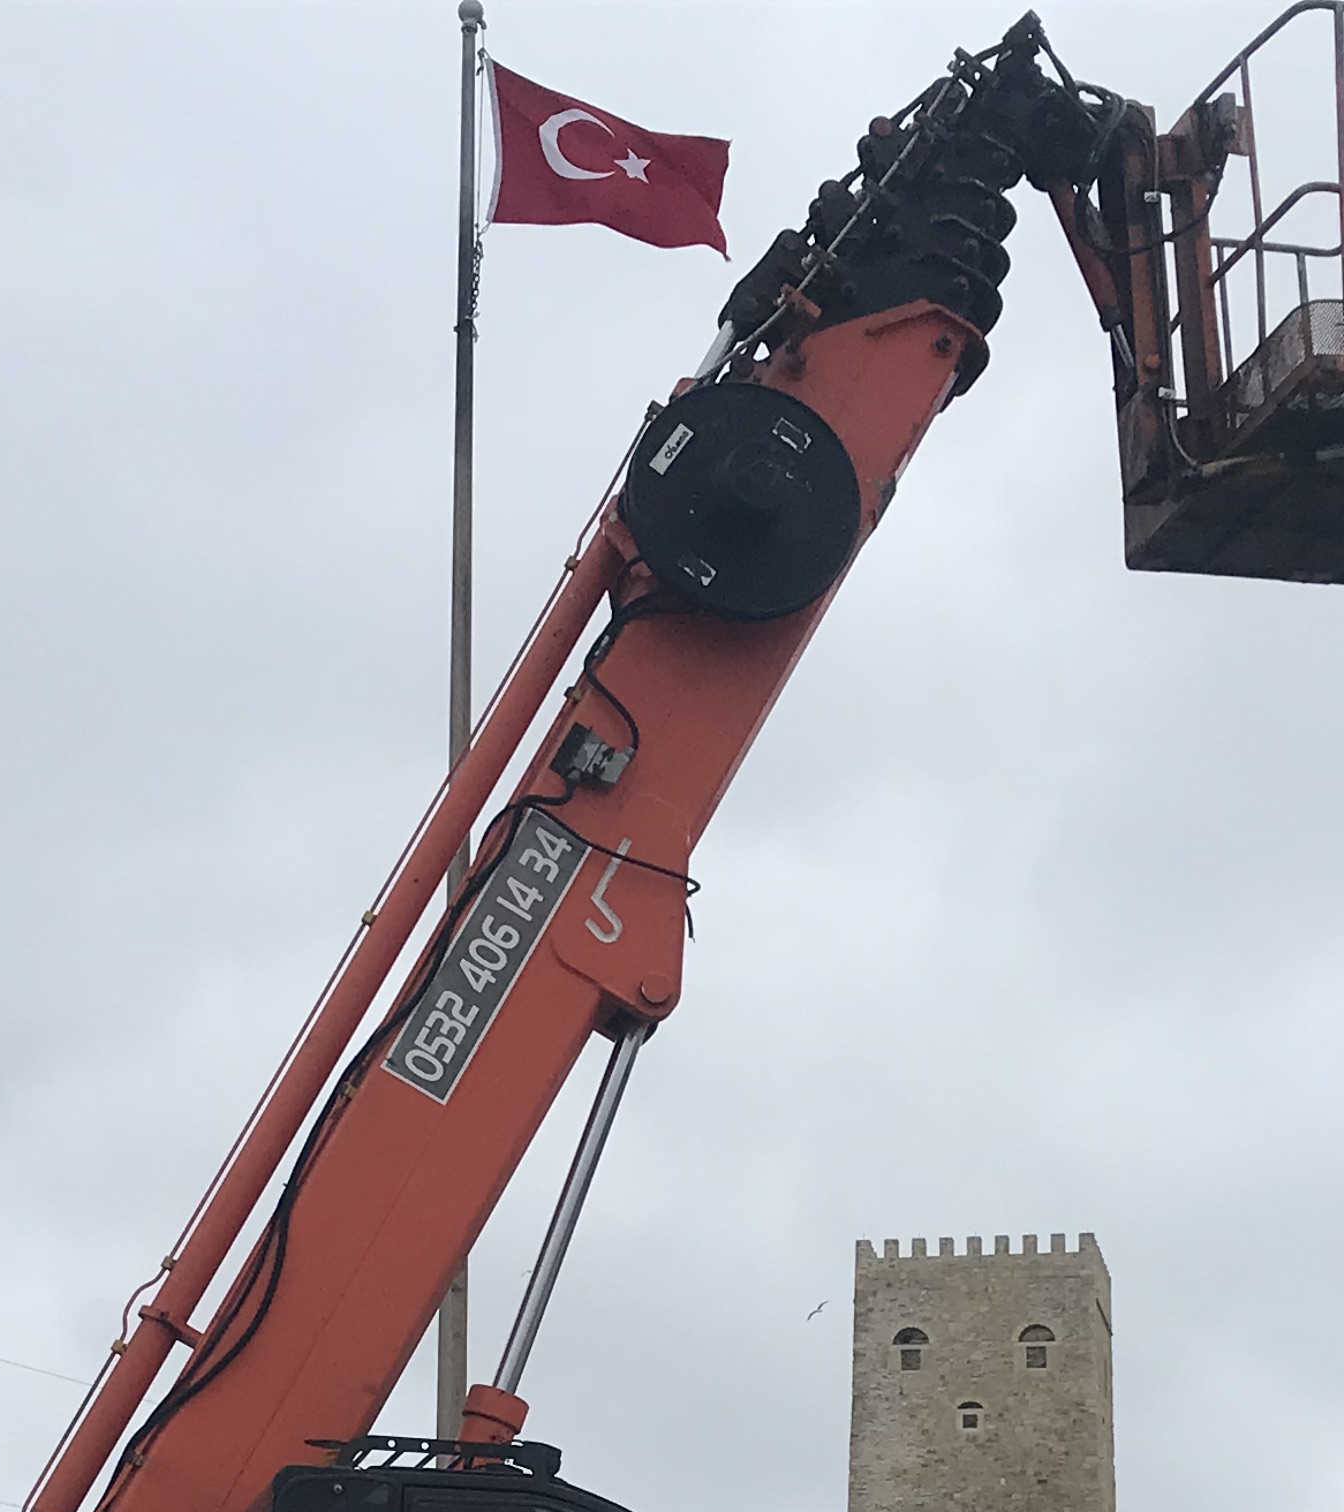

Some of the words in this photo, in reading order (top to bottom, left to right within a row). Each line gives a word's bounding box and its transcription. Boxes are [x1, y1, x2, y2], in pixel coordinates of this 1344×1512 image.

[518, 826, 572, 883] 34
[496, 876, 543, 921] 14
[459, 914, 520, 993] 406
[405, 990, 480, 1082] 0532
